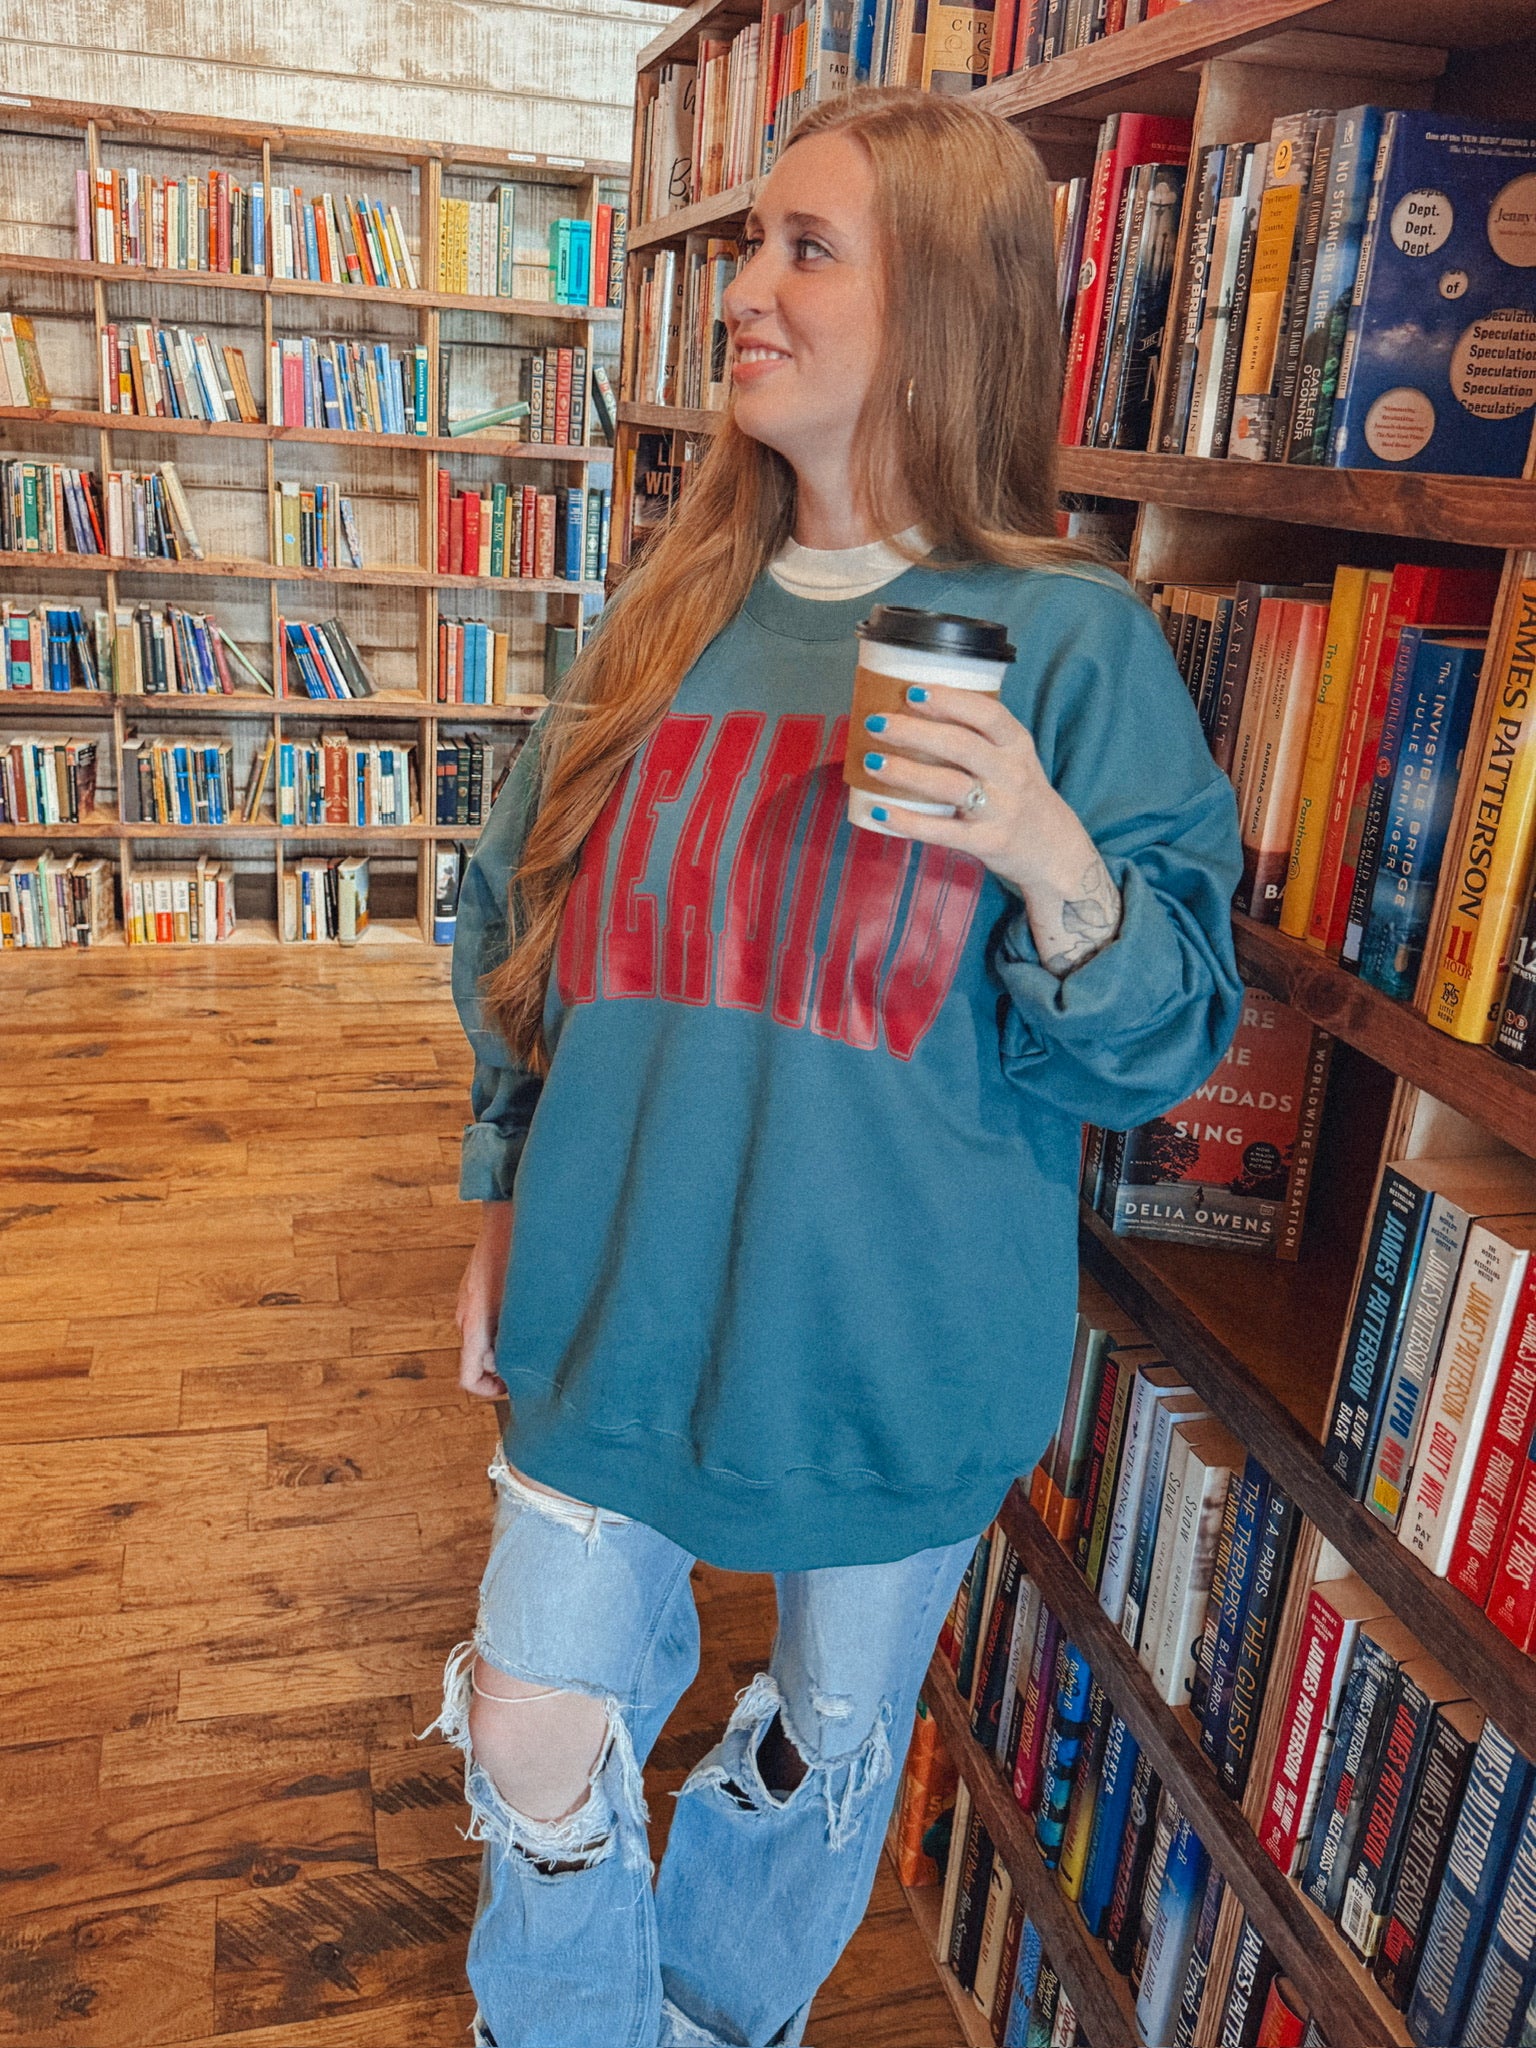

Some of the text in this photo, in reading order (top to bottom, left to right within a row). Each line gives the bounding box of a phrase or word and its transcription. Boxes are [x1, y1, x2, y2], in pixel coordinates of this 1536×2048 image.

[1277, 145, 1288, 171] 2
[1375, 146, 1387, 174] Dept.
[1094, 158, 1112, 242] GRAHAM
[1305, 147, 1330, 246] FLANNERY O'CONNOR
[1408, 202, 1441, 219] Dept.
[1494, 208, 1531, 226] Jenny
[1314, 161, 1350, 330] NO STRANGERS HERE
[1401, 240, 1430, 257] Dept
[1405, 221, 1437, 237] Dept.
[1118, 200, 1145, 326] LAST DAYS NIGHT
[1185, 218, 1211, 344] TIM O'BRIEN
[1230, 236, 1252, 333] Tim O'Brien
[1298, 268, 1311, 295] GOOD
[1354, 240, 1372, 300] Speculation
[1446, 282, 1460, 294] of
[1293, 318, 1304, 328] IS
[1296, 297, 1306, 316] MAN
[1287, 359, 1297, 372] TO
[1289, 331, 1301, 358] HARD
[1282, 374, 1295, 398] FIND
[1293, 364, 1312, 441] O'CONNOR
[1303, 368, 1321, 437] CARLENE
[1462, 381, 1533, 397] Speculation
[494, 522, 503, 542] KIM
[1185, 622, 1193, 647] THE
[1198, 623, 1207, 649] THE
[1203, 609, 1227, 700] WARLIGHT
[1324, 643, 1338, 670] The
[1216, 599, 1249, 747] WARLIGHT
[1318, 675, 1333, 704] Dog
[1382, 646, 1411, 752] SUSAN ORLEAN
[1386, 692, 1428, 870] JULIE ORRINGER
[1394, 661, 1452, 908] The INVISIBLE BRIDGE
[1458, 592, 1536, 921] JAMES PATTERSON
[1251, 742, 1272, 834] BARBARA O'NEAL
[1363, 811, 1381, 881] ORCHID
[1443, 957, 1473, 981] HOUR
[1190, 1084, 1294, 1114] WDADS
[1301, 1050, 1327, 1150] WORLDWIDE
[1173, 1121, 1244, 1146] SING
[1125, 1202, 1186, 1221] DELIA
[1194, 1210, 1273, 1235] OWENS
[1284, 1157, 1309, 1248] SENSATION
[1481, 1249, 1500, 1265] WORLD'S
[1488, 1245, 1497, 1254] THE
[1348, 1210, 1408, 1402] JAMES PATTERSON
[1402, 1249, 1451, 1382] JAMES PATTERSON
[1440, 1281, 1495, 1425] JAMES PATTERSON
[1333, 1401, 1354, 1444] BACK
[1350, 1404, 1370, 1451] BLOW
[1378, 1377, 1421, 1483] NYPD RED
[1497, 1360, 1536, 1446] PATTERSON
[1092, 1420, 1109, 1455] RED
[1101, 1388, 1126, 1494] THE WICKED WILL
[1426, 1420, 1457, 1482] GUILTY
[1480, 1446, 1514, 1508] PRIVATE
[1412, 1536, 1424, 1550] PB
[1415, 1523, 1431, 1543] PAT
[1417, 1512, 1424, 1521] F
[1467, 1498, 1501, 1557] LONDON
[1210, 1492, 1241, 1610] SARA PARETSKY
[1255, 1498, 1285, 1599] B. A. PARIS
[1505, 1533, 1532, 1590] PARIS
[1172, 1564, 1183, 1606] ORHAN
[1209, 1480, 1260, 1717] THE THERAPIST B. A. PARIS
[1226, 1610, 1268, 1760] THE GUEST
[1283, 1636, 1326, 1787] JAMES PATTERSON
[1359, 1676, 1379, 1719] JAMES
[1108, 1717, 1126, 1786] ROBERT
[1344, 1710, 1370, 1777] PATTERSON
[1386, 1704, 1418, 1774] JAMES
[1271, 1780, 1287, 1819] LAWYER
[1280, 1787, 1298, 1838] THE FAMILY
[1362, 1762, 1405, 1870] PATTERSON
[1419, 1748, 1455, 1828] JAMES
[1319, 1772, 1355, 1877] TARGET ALEX CROSS
[1449, 1771, 1501, 1897] PATTERSON
[1351, 1885, 1364, 1901] 102
[1356, 1861, 1369, 1881] NO
[1393, 1813, 1442, 1936] PATTERSON
[1153, 1907, 1169, 1957] PAINTED
[1236, 1918, 1265, 1998] JAMES
[1183, 1944, 1209, 2018] Perish
